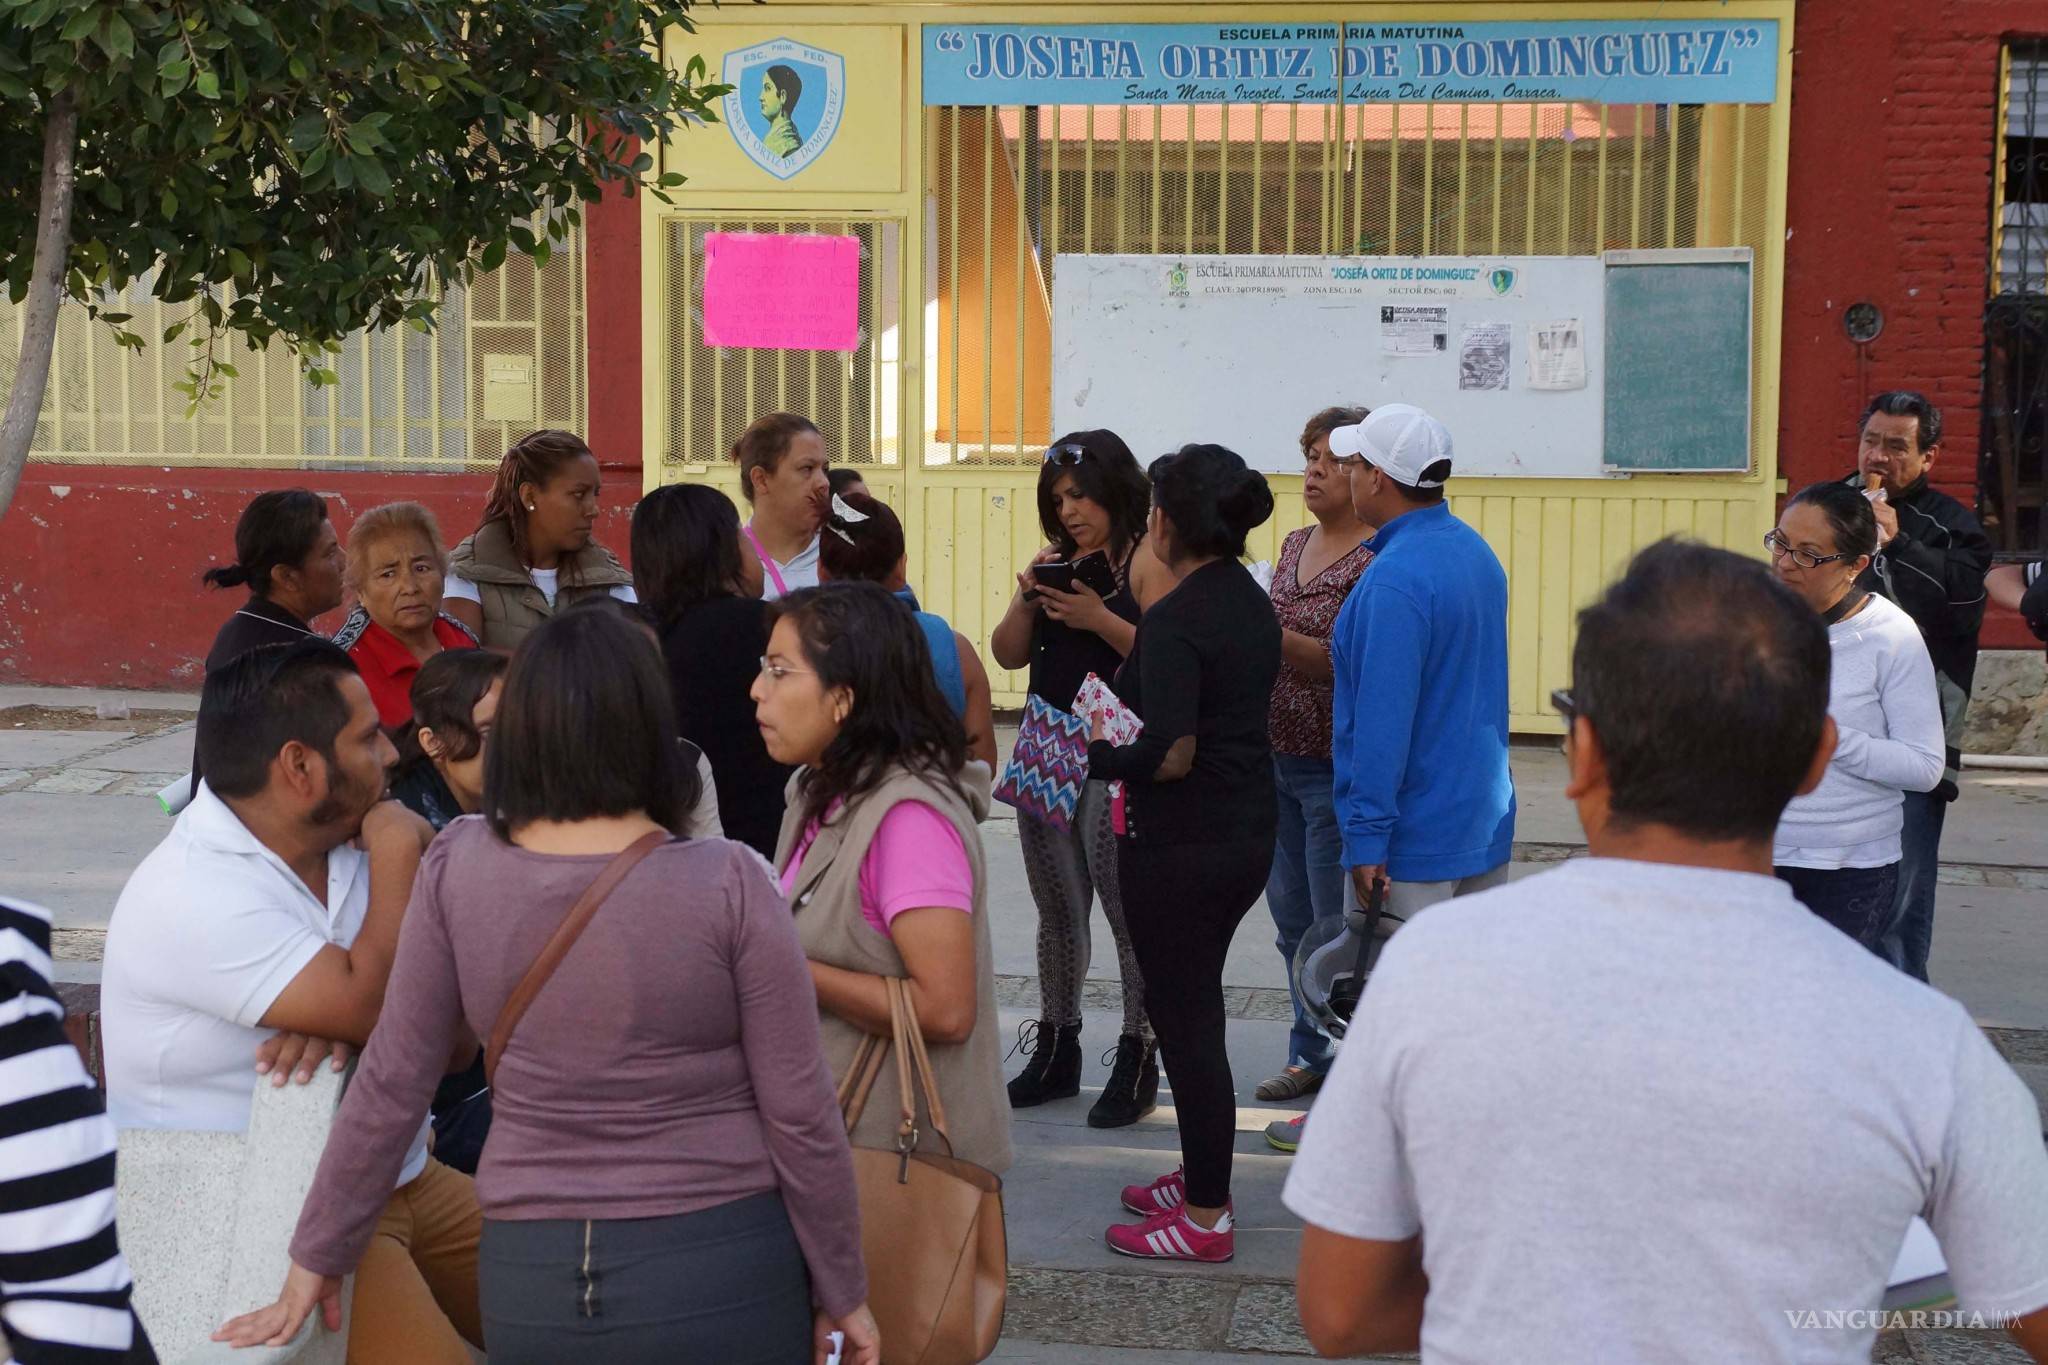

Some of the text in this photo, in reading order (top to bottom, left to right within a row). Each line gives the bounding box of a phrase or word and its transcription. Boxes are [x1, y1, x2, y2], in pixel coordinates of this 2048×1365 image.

[1219, 27, 1464, 40] ESCUELA PRIMARIA MATUTINA
[743, 52, 767, 62] ESC.
[803, 50, 828, 63] FED.
[1160, 43, 1314, 80] ORTIZ
[1329, 44, 1400, 79] DE
[1124, 83, 1169, 100] Santa
[1293, 82, 1339, 99] Santa
[1399, 83, 1425, 99] Del
[753, 140, 781, 166] ORTIZ
[783, 158, 795, 169] DE
[1196, 266, 1323, 278] ESCUELA PRIMARIA MATUTINA
[1371, 267, 1398, 280] ORTIZ
[1401, 267, 1413, 280] DE
[1205, 286, 1234, 294] CLAVE:
[1303, 286, 1327, 294] ZONA
[1350, 286, 1362, 294] 156
[1388, 287, 1423, 295] SECTOR
[1443, 287, 1457, 295] 002
